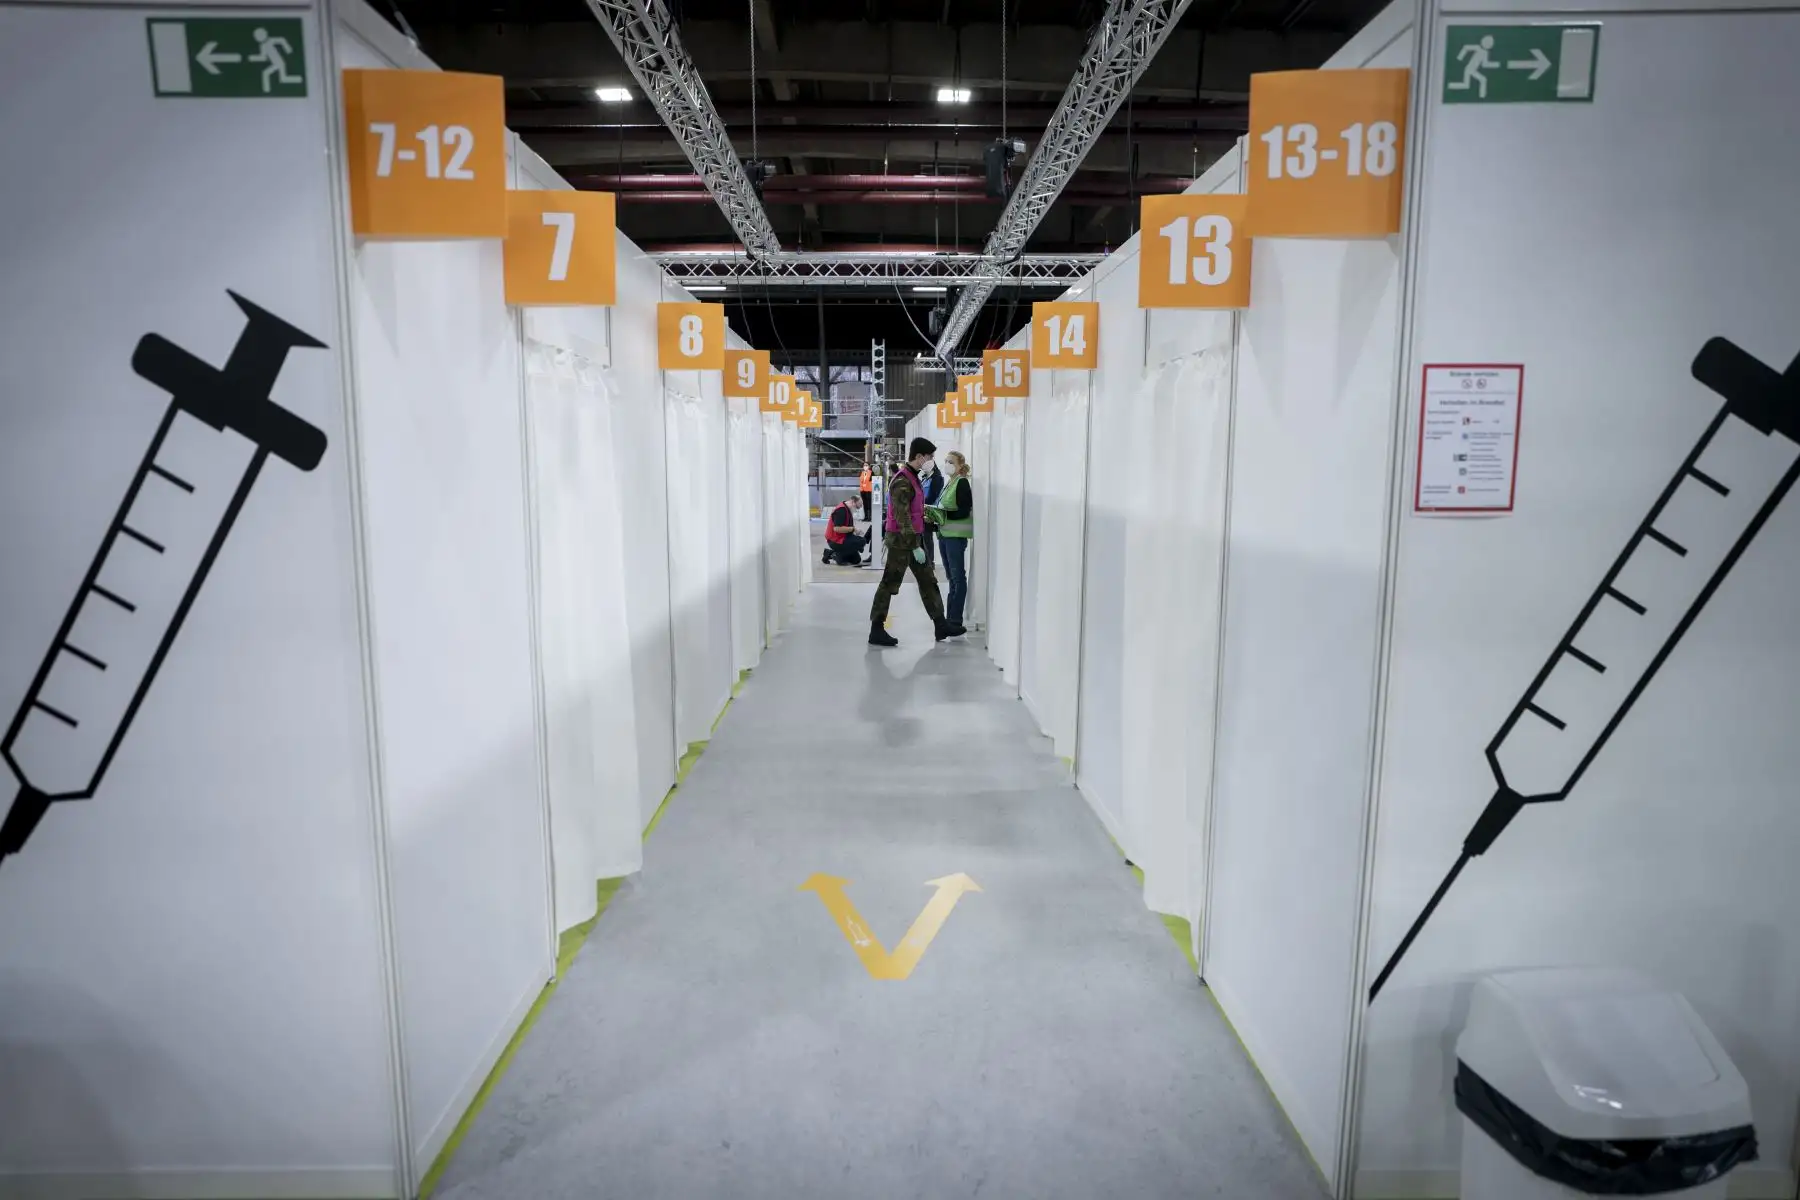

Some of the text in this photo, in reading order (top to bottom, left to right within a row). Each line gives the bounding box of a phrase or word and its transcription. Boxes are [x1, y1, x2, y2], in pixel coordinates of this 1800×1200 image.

[369, 123, 474, 180] 7-12
[1260, 121, 1398, 179] 13-18
[542, 212, 575, 281] 7
[1159, 214, 1233, 286] 13
[679, 314, 703, 357] 8
[1043, 314, 1087, 356] 14
[737, 358, 756, 389] 9
[768, 381, 790, 405] 10
[990, 358, 1022, 388] 15
[951, 397, 967, 417] 1
